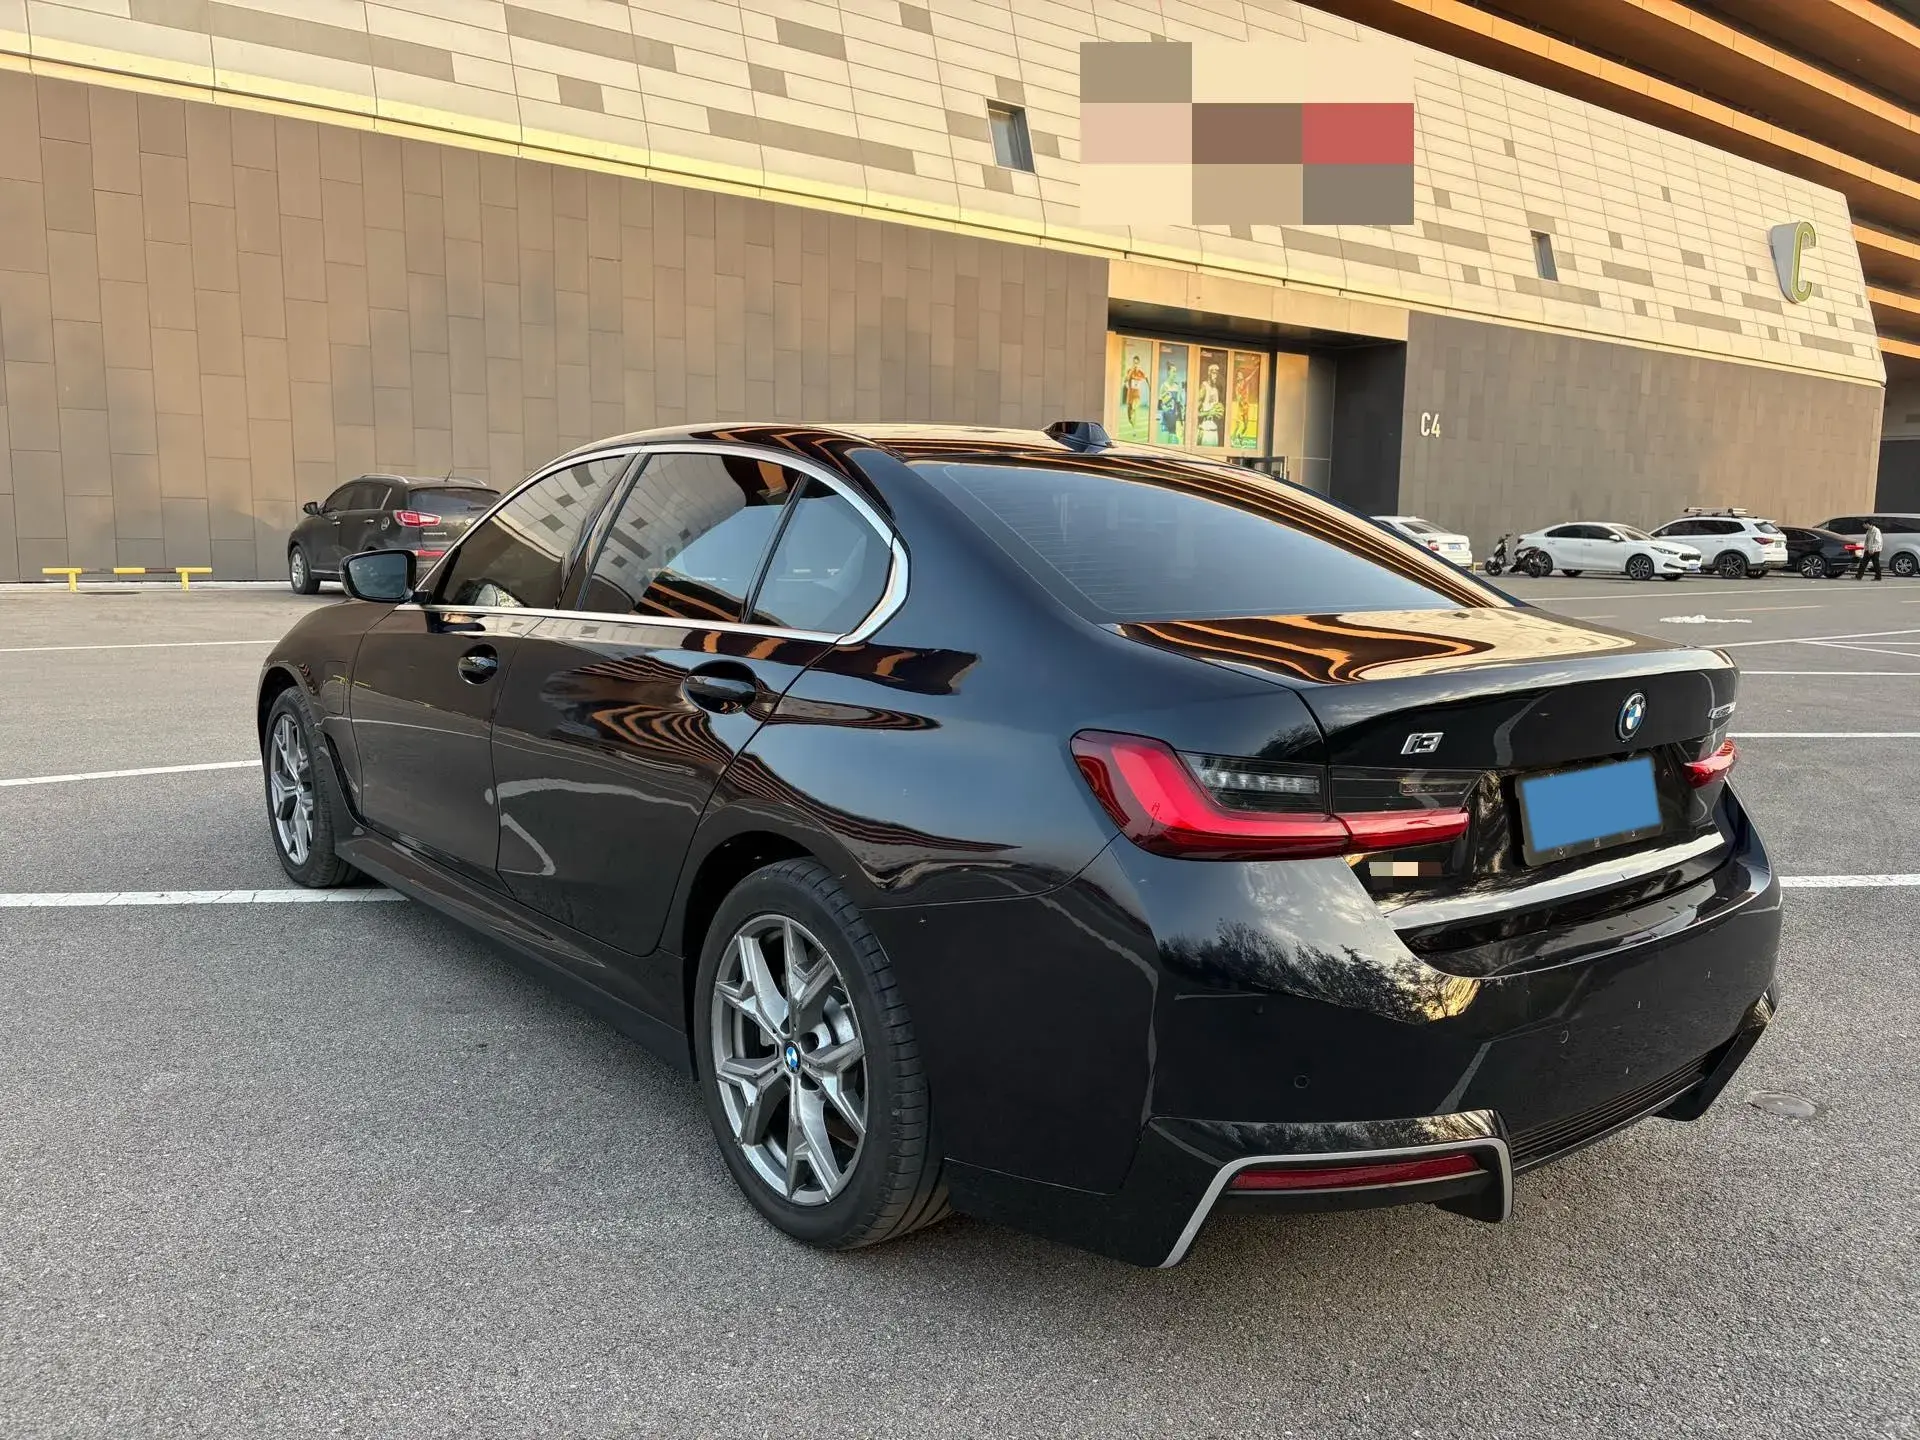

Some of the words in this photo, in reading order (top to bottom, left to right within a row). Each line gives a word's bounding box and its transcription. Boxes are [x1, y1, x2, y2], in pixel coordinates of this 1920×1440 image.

[1790, 221, 1817, 302] C
[1420, 412, 1441, 438] C4
[1400, 731, 1444, 754] i3
